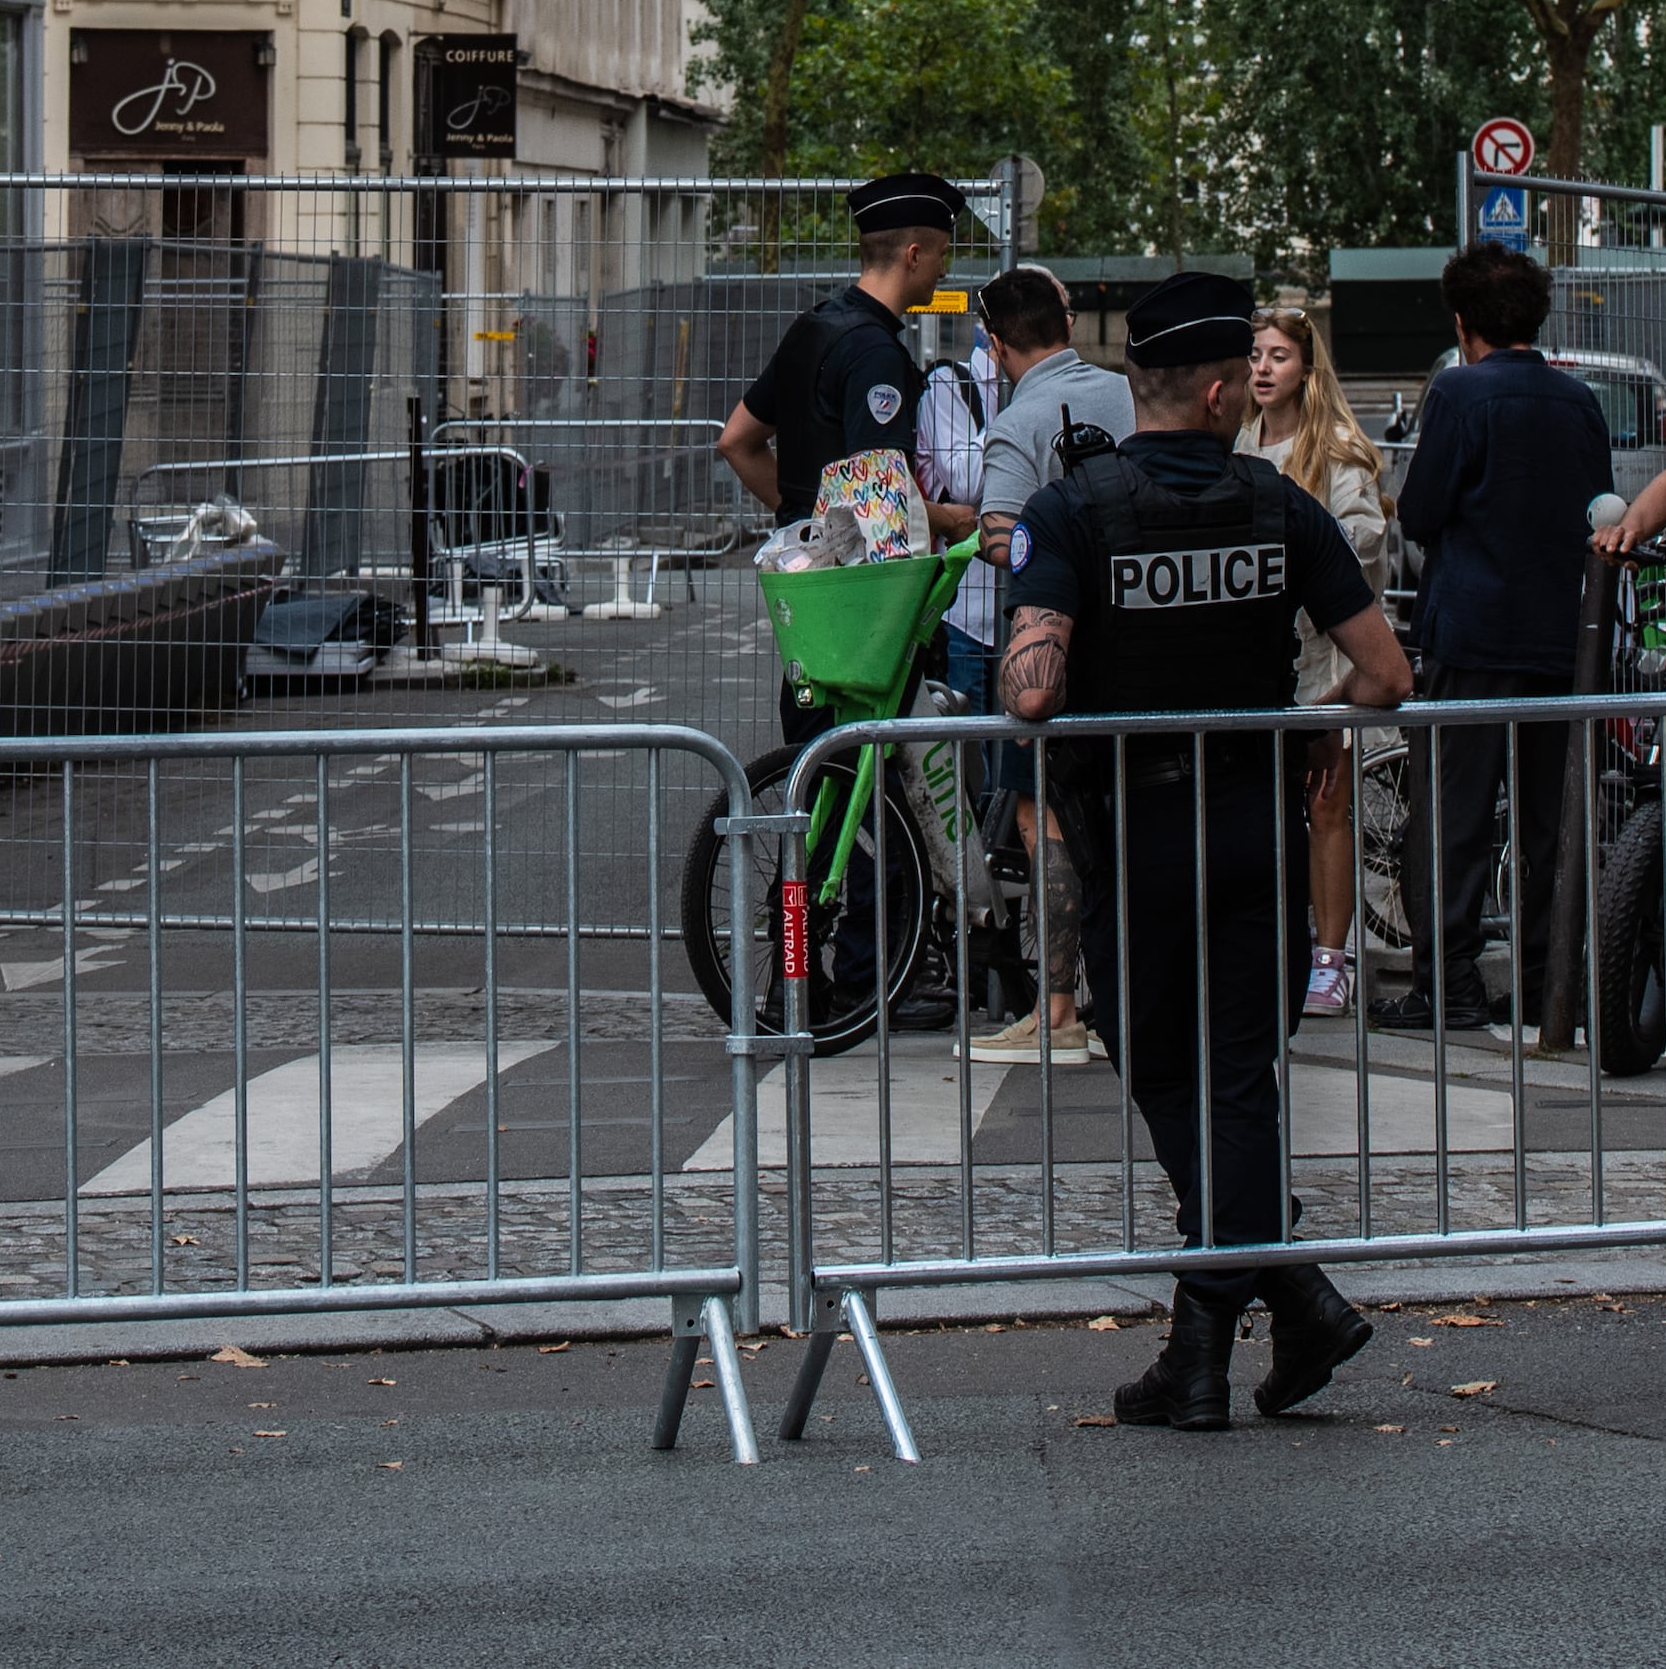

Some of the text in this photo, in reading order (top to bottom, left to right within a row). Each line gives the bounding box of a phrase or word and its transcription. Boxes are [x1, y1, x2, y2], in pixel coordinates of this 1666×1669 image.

[445, 49, 514, 63] COIFFURE
[155, 121, 225, 134] Jenny & Paola
[445, 132, 514, 143] Jenny & Paola
[1113, 549, 1284, 606] POLICE
[783, 909, 796, 974] ALTRAD
